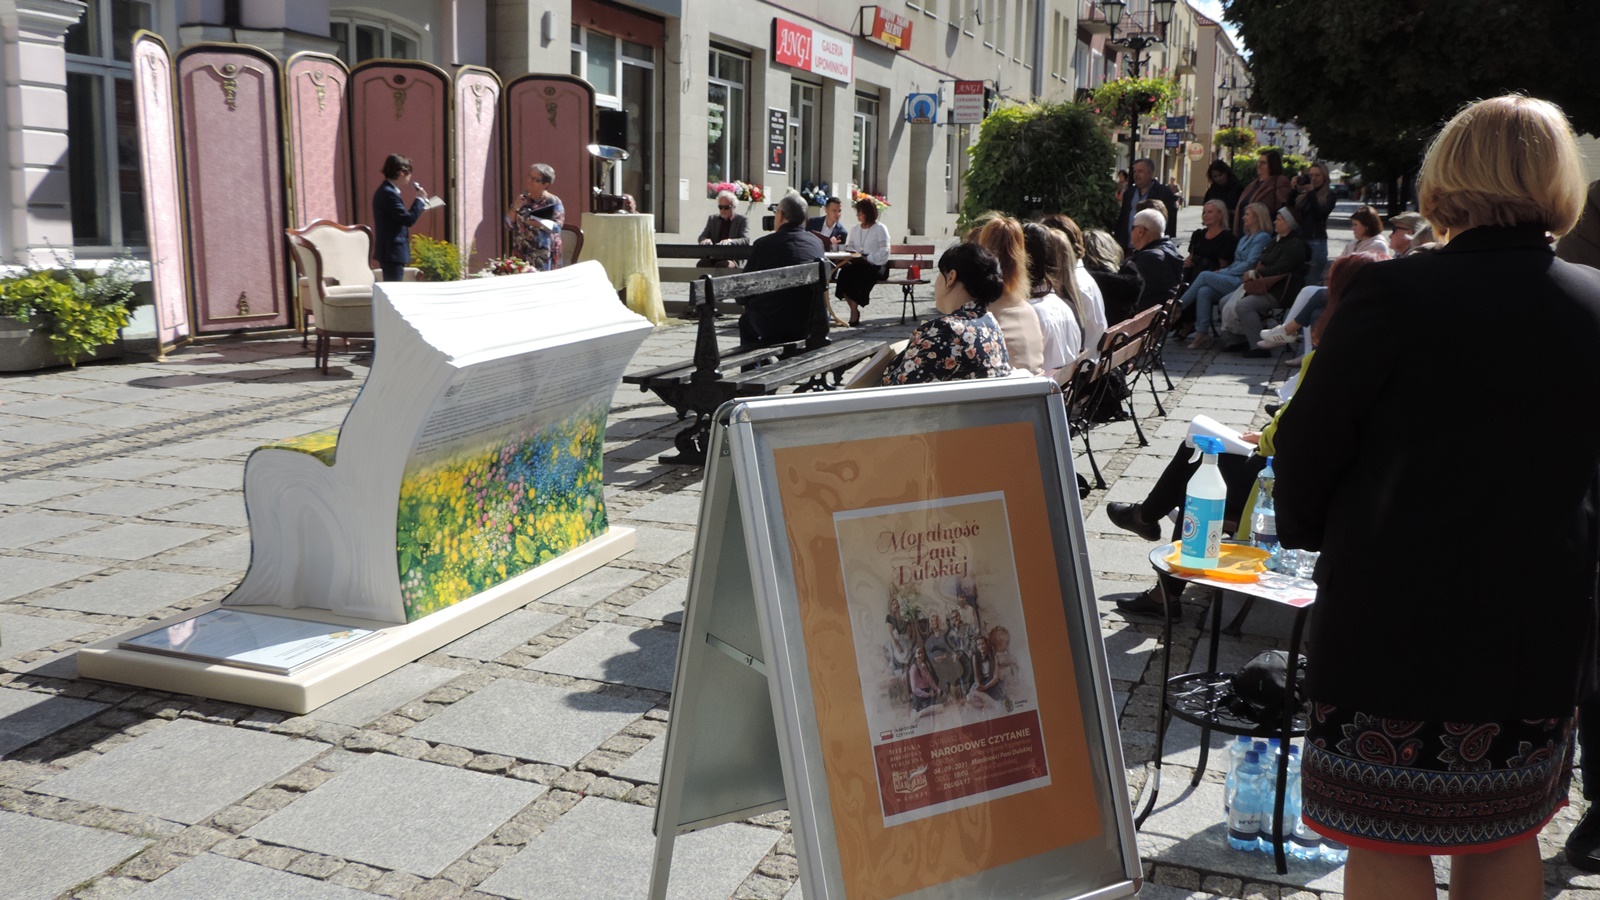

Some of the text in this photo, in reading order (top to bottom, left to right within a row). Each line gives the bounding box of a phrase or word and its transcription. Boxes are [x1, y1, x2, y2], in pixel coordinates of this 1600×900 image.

[777, 28, 811, 67] ANGI
[822, 39, 843, 57] GALERIA
[815, 55, 848, 77] UPOMINKÓW
[957, 84, 981, 94] ANGI
[877, 520, 979, 553] Moralność
[908, 540, 956, 565] Pani
[892, 556, 967, 585] Dulskiej
[889, 744, 921, 754] MIEJSKA
[930, 728, 1030, 758] NARODOWE CZYTANIE
[1012, 745, 1033, 755] Dulskiej
[934, 762, 968, 774] 04.09.2021
